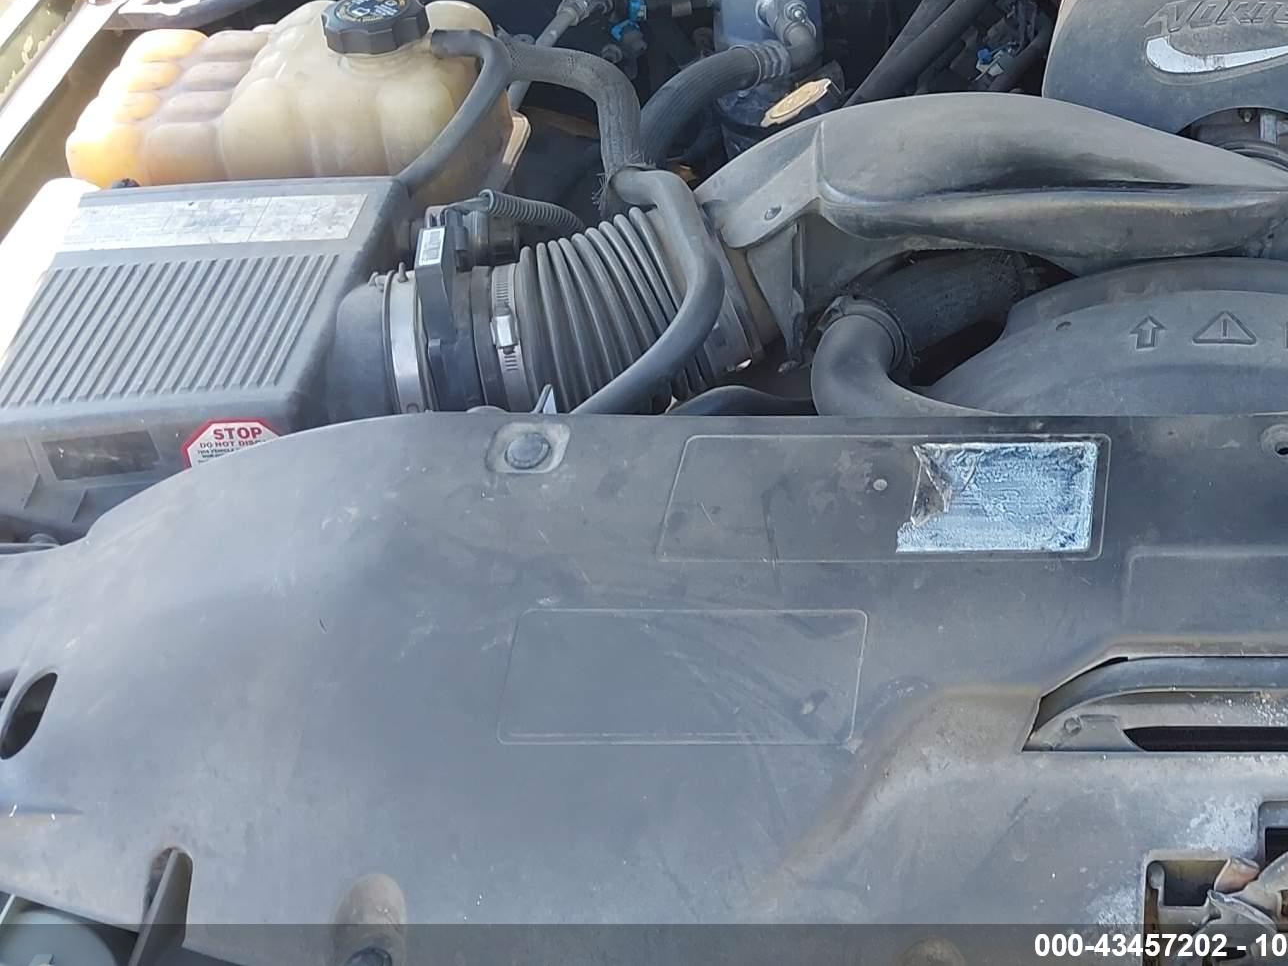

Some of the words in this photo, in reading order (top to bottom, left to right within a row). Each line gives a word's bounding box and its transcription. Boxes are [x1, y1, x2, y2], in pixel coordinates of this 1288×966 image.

[213, 427, 263, 440] STOP
[199, 441, 214, 449] DO
[214, 440, 235, 448] NOT
